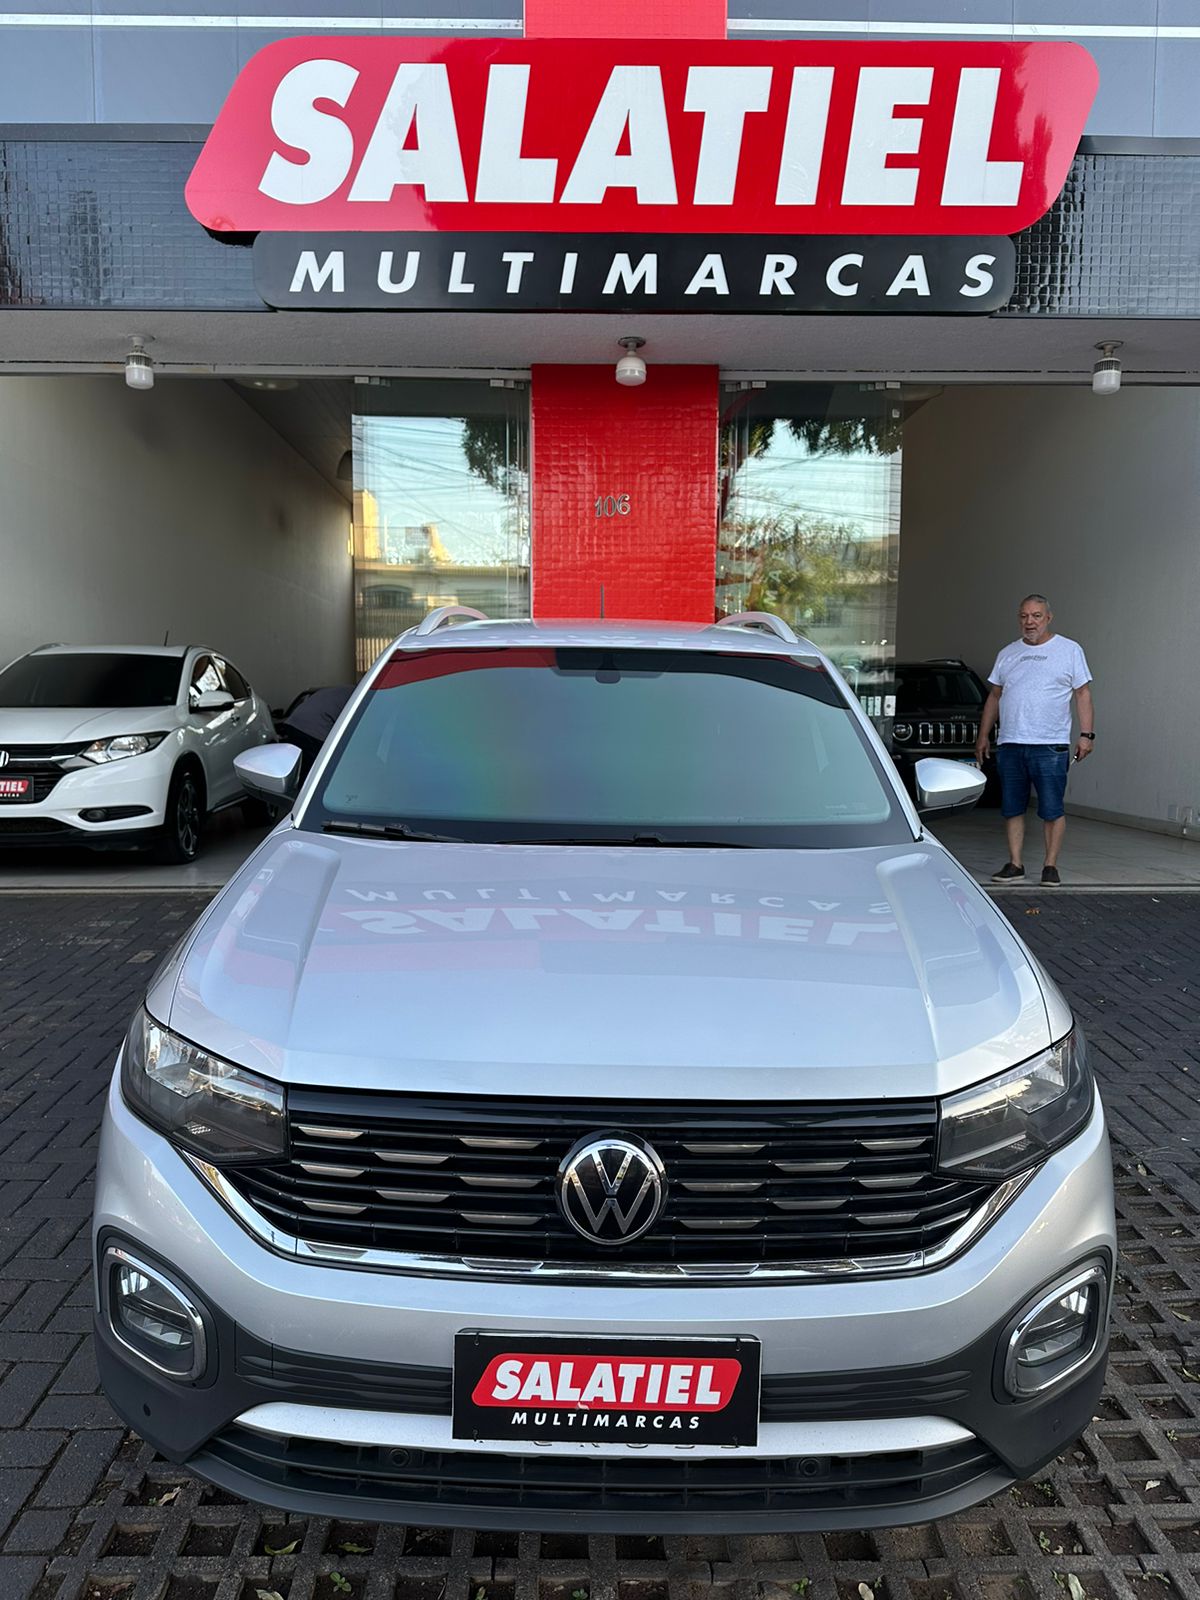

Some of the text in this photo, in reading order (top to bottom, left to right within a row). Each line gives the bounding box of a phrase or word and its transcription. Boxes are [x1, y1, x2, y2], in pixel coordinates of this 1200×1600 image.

[258, 59, 1025, 207] SALATIEL
[288, 250, 997, 299] MULTIMARCAS
[594, 493, 631, 518] 106
[0, 780, 25, 793] TIEL
[490, 1359, 722, 1406] SALATIEL
[511, 1411, 701, 1430] MULTIMARCAS
